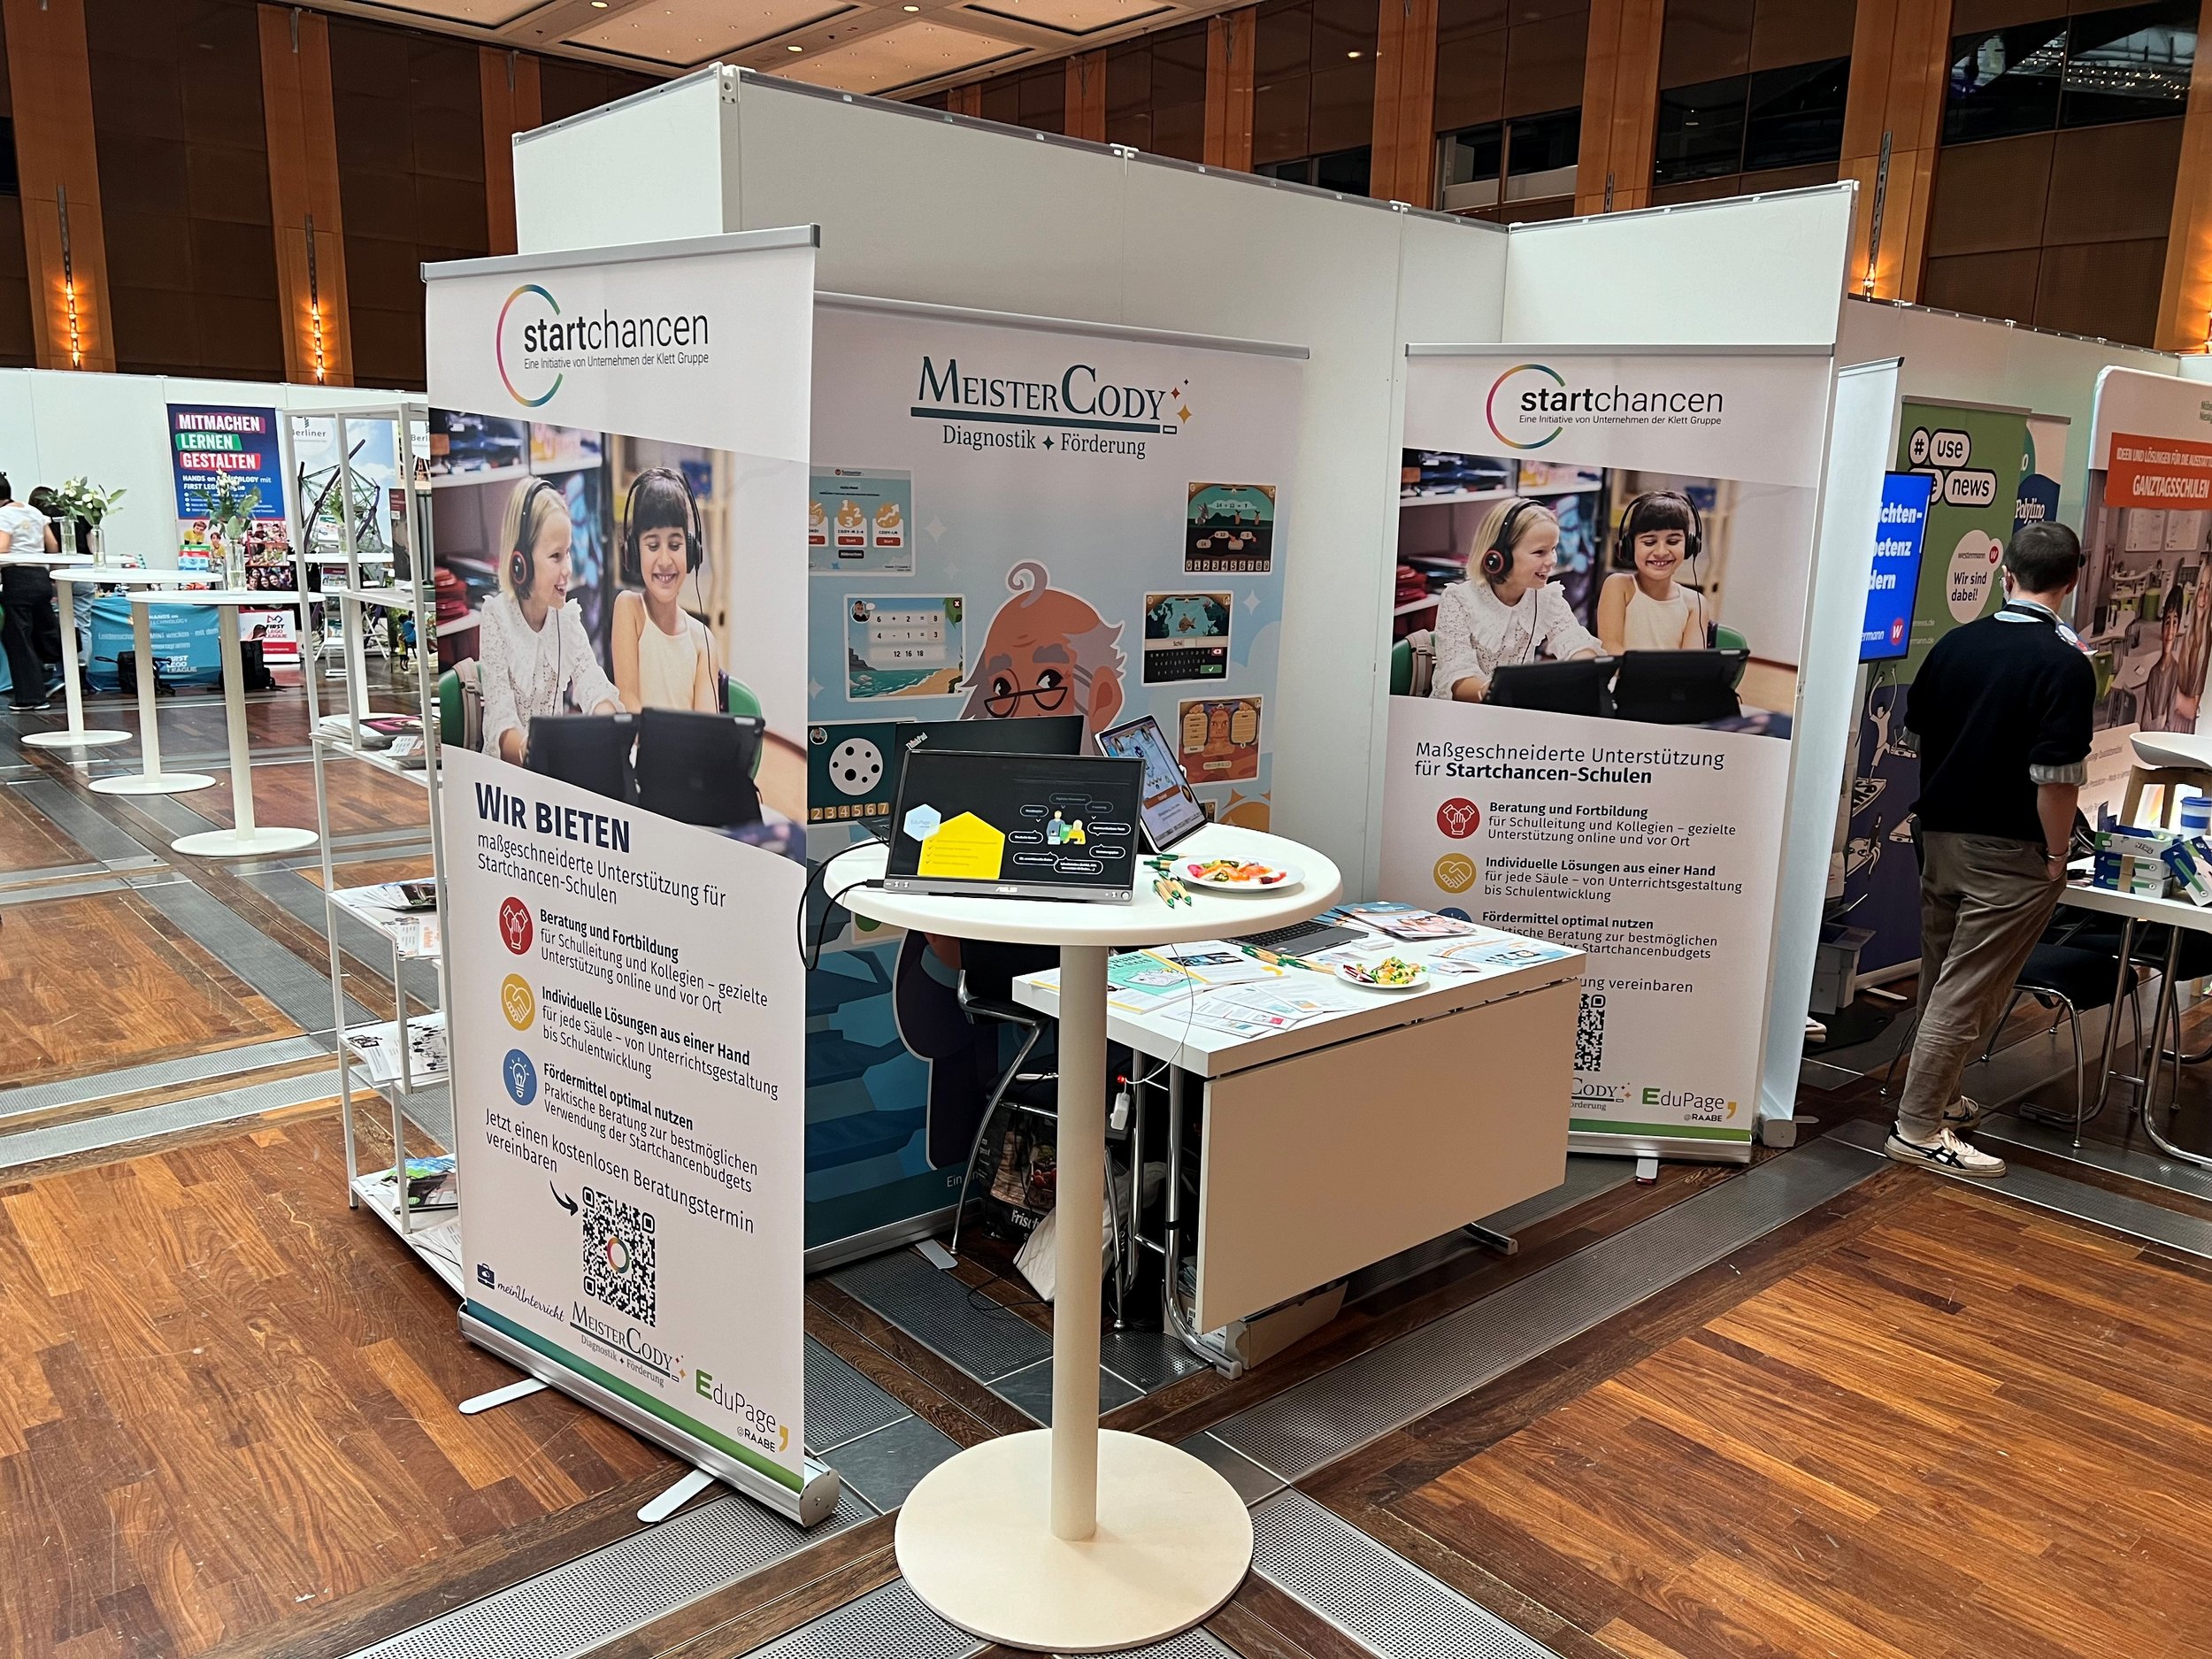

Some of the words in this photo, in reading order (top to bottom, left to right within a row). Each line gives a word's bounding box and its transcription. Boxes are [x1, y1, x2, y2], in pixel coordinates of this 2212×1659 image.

[525, 309, 709, 353] startchancen
[525, 358, 539, 369] Eine
[541, 357, 571, 369] Initiative
[572, 358, 586, 367] von
[588, 355, 640, 367] Unternehmen
[641, 354, 655, 365] der
[657, 353, 675, 365] Klett
[678, 351, 709, 365] Gruppe
[1520, 385, 1723, 412] startchancen
[179, 415, 260, 431] MITMACHEN
[1519, 415, 1537, 424] Eine
[1539, 414, 1573, 424] Initiative
[1593, 415, 1649, 425] Unternehmen
[1651, 416, 1665, 425] der
[1668, 416, 1687, 425] Klett
[1690, 416, 1721, 426] Gruppe
[180, 434, 233, 449] LERNEN
[942, 425, 1036, 451] Diagnostik
[1061, 433, 1146, 460] Förderung
[1937, 441, 1962, 458] use
[182, 453, 257, 469] GESTALTEN
[1952, 478, 1989, 497] news
[2133, 474, 2210, 498] GANZTAGSSCHULEN
[2015, 497, 2045, 524] Polylino
[1954, 572, 1969, 585] Wir
[1970, 571, 1986, 585] sind
[1951, 588, 1978, 602] dabei!
[906, 732, 928, 750] ThinkPad
[1416, 742, 1585, 764] Maßgeschneiderte
[1592, 747, 1724, 771] Unterstützung
[1415, 760, 1440, 777] für
[1446, 762, 1652, 784] Startchancen-Schulen
[475, 782, 526, 830] WIR
[536, 803, 630, 854] BIETEN
[1489, 802, 1546, 816] Beratung
[1548, 803, 1572, 815] und
[1576, 804, 1647, 820] Fortbildung
[1487, 828, 1574, 844] Unterstützung
[1577, 831, 1615, 843] online
[1619, 833, 1643, 845] und
[1647, 836, 1668, 846] vor
[1671, 834, 1690, 847] Ort
[1488, 815, 1507, 827] für
[1509, 816, 1586, 833] Schulleitung
[1588, 818, 1612, 831] und
[1617, 820, 1673, 837] Kollegien
[1688, 823, 1736, 838] gezielte
[478, 833, 594, 876] maßgeschneiderte
[597, 861, 699, 905] Unterstützung
[703, 885, 726, 907] für
[1486, 856, 1558, 870] Individuelle
[1561, 858, 1620, 875] Lösungen
[1624, 864, 1644, 874] aus
[1648, 863, 1679, 875] einer
[1684, 864, 1716, 877] Hand
[478, 854, 618, 905] Startchancen-Schulen
[1485, 870, 1502, 882] für
[1505, 871, 1531, 886] jede
[1535, 872, 1569, 885] Säule
[1583, 876, 1604, 886] von
[1609, 875, 1742, 895] Unterrichtsgestaltung
[1485, 884, 1502, 896] bis
[1505, 885, 1611, 902] Schulentwicklung
[1483, 911, 1558, 926] Fördermittel
[1562, 913, 1609, 929] optimal
[1611, 917, 1654, 930] nutzen
[541, 909, 587, 938] Beratung
[589, 921, 610, 941] und
[612, 929, 679, 964] Fortbildung
[1495, 926, 1544, 939] ktische
[1548, 928, 1602, 943] Beratung
[1605, 933, 1624, 942] zur
[1628, 933, 1717, 949] bestmöglichen
[1582, 942, 1711, 961] Startchancenbudgets
[541, 928, 556, 944] für
[558, 934, 623, 969] Schulleitung
[626, 955, 647, 972] und
[651, 963, 704, 989] Kollegien
[718, 983, 768, 1007] gezielte
[541, 947, 613, 984] Unterstützung
[617, 971, 651, 993] online
[655, 980, 676, 1001] und
[680, 992, 699, 1006] vor
[703, 995, 722, 1013] Ort
[1609, 979, 1694, 993] vereinbaren
[542, 987, 603, 1018] Individuelle
[604, 1005, 657, 1038] Lösungen
[660, 1026, 680, 1043] aus
[683, 1033, 714, 1055] einer
[717, 1042, 750, 1066] Hand
[542, 1005, 557, 1021] für
[559, 1010, 580, 1033] jede
[583, 1016, 612, 1041] Säule
[625, 1036, 645, 1053] von
[648, 1043, 779, 1100] Unterrichtsgestaltung
[543, 1025, 557, 1041] bis
[560, 1030, 651, 1079] Schulentwicklung
[544, 1064, 607, 1098] Fördermittel
[610, 1087, 651, 1115] optimal
[654, 1106, 693, 1130] nutzen
[1571, 1077, 1618, 1098] CODY
[1642, 1087, 1724, 1112] EduPage
[1570, 1100, 1607, 1111] örderung
[1684, 1113, 1723, 1122] @RAABE
[544, 1083, 596, 1114] Praktische
[599, 1102, 647, 1138] Beratung
[649, 1123, 667, 1140] zur
[671, 1129, 757, 1176] bestmöglichen
[486, 1132, 557, 1174] vereinbaren
[544, 1102, 606, 1140] Verwendung
[609, 1125, 626, 1143] der
[629, 1131, 752, 1194] Startchancenbudgets
[486, 1108, 511, 1134] Jetzt
[515, 1121, 548, 1148] einen
[552, 1133, 629, 1183] kostenlosen
[634, 1169, 754, 1234] Beratungstermin
[947, 1175, 963, 1187] Ein
[497, 1281, 565, 1324] meinUnterricht
[581, 1334, 618, 1363] Diagnostik
[626, 1359, 664, 1388] Förderung
[695, 1369, 776, 1433] EduPage
[736, 1426, 776, 1454] @RAABE
